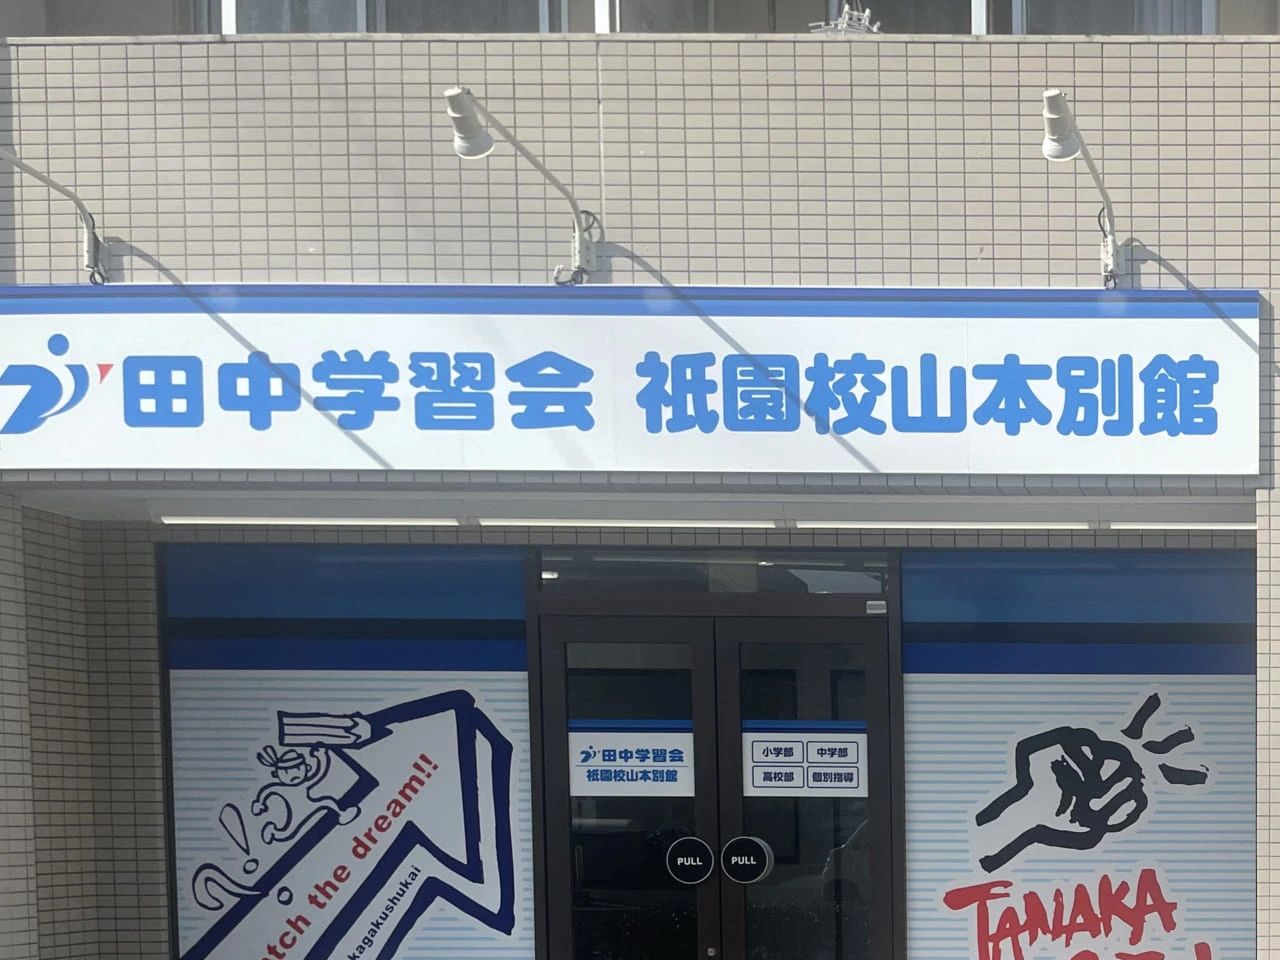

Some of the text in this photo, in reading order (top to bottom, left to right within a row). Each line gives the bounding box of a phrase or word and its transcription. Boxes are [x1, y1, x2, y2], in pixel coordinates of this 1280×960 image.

[123, 350, 1219, 437] 田中学習会 祇園校山本別館
[602, 748, 685, 763] 田中学習会
[762, 747, 795, 758] 小学部
[816, 747, 849, 758] 中学部
[586, 769, 678, 783] 祇園校山本別館
[762, 772, 795, 783] 高校部
[812, 772, 854, 783] 個別指導
[307, 864, 352, 910] the
[351, 752, 440, 861] dream!!
[677, 856, 703, 866] PULL
[731, 855, 757, 865] PULL
